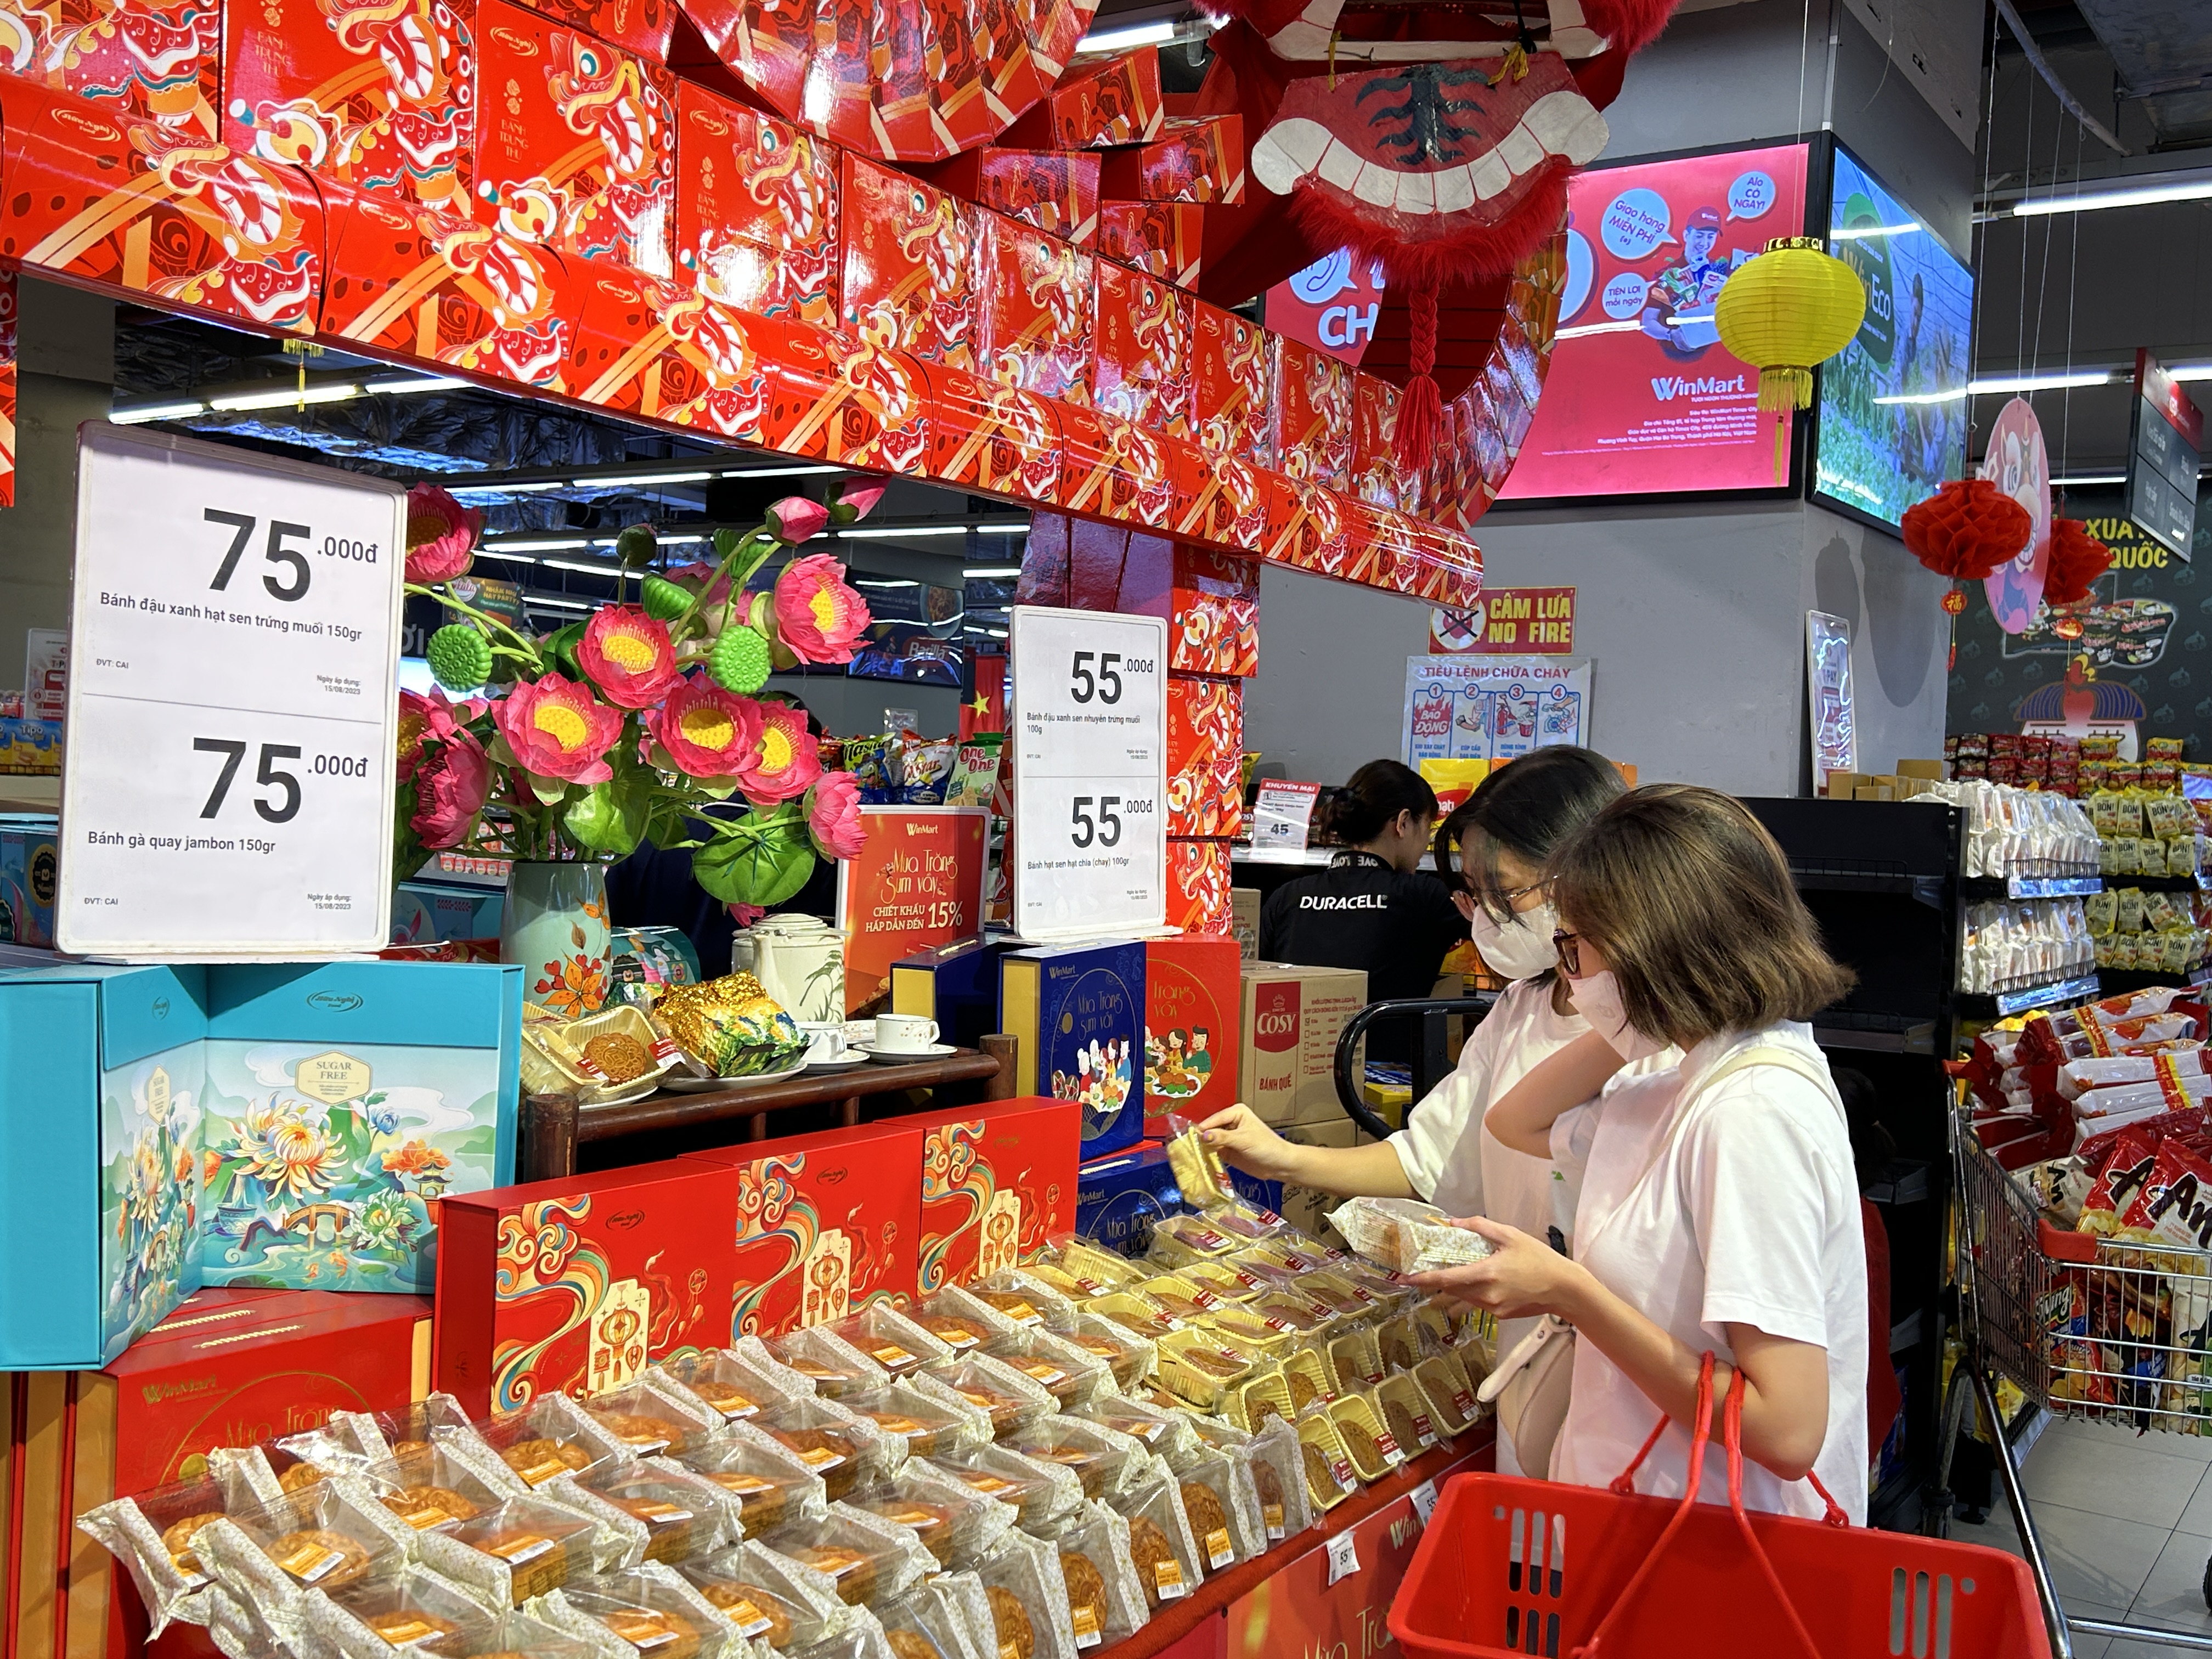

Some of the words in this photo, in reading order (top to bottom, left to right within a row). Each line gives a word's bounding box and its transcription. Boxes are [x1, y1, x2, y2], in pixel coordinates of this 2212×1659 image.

[1615, 199, 1638, 218] Giao
[1638, 210, 1666, 234] hàng
[1651, 374, 1745, 401] WinMart
[2109, 540, 2169, 570] QUỐC
[100, 591, 136, 610] Bánh
[139, 597, 166, 614] đậu
[169, 602, 201, 619] xanh
[204, 606, 225, 622] hạt
[228, 612, 252, 625] sen
[255, 613, 289, 634] trứng
[292, 616, 324, 636] muối
[326, 624, 363, 642] 150gr
[1488, 622, 1517, 644] NO
[1528, 622, 1571, 644] FIRE
[909, 641, 947, 661] Barilla
[1456, 664, 1489, 680] LỆNH
[1533, 665, 1571, 679] CHÁY
[1433, 686, 1439, 696] 1
[1468, 686, 1475, 697] 2
[1513, 685, 1521, 697] 3
[1554, 687, 1562, 697] 4
[1026, 712, 1042, 722] Bánh
[1043, 713, 1056, 723] đậu
[1057, 714, 1071, 723] xanh
[1420, 708, 1441, 720] BÁO
[1026, 724, 1042, 735] 100g
[1414, 720, 1448, 736] ĐỘNG
[960, 747, 986, 764] One
[968, 758, 996, 774] One
[906, 822, 939, 837] WinMart
[1271, 823, 1289, 836] 45
[88, 830, 124, 847] Bánh
[128, 832, 146, 849] gà
[149, 836, 182, 851] quay
[184, 835, 235, 853] jambon
[238, 837, 276, 855] 150gr
[893, 847, 919, 873] Mùa
[923, 849, 958, 880] Trăng
[1027, 860, 1043, 870] Bánh
[1043, 860, 1054, 870] hạt
[1067, 860, 1077, 869] hạt
[1079, 858, 1091, 868] chia
[1112, 856, 1130, 867] 100gr
[873, 905, 899, 918] CHIẾT
[900, 903, 926, 916] KHẤU
[1299, 895, 1387, 911] DURACELL
[865, 919, 885, 933] HẤP
[886, 919, 905, 932] DẪN
[906, 918, 925, 930] ĐẾN
[928, 900, 963, 929] 15%
[1153, 979, 1196, 1006] Trăng
[1098, 990, 1124, 1014] Trăng
[1257, 1012, 1297, 1036] COSY
[316, 1060, 352, 1070] SUGAR
[320, 1071, 348, 1080] FREE
[1259, 1075, 1278, 1092] BÁNH
[1279, 1071, 1292, 1090] QUẾ
[142, 1374, 217, 1406] WinMart
[1340, 1549, 1348, 1566] 55
